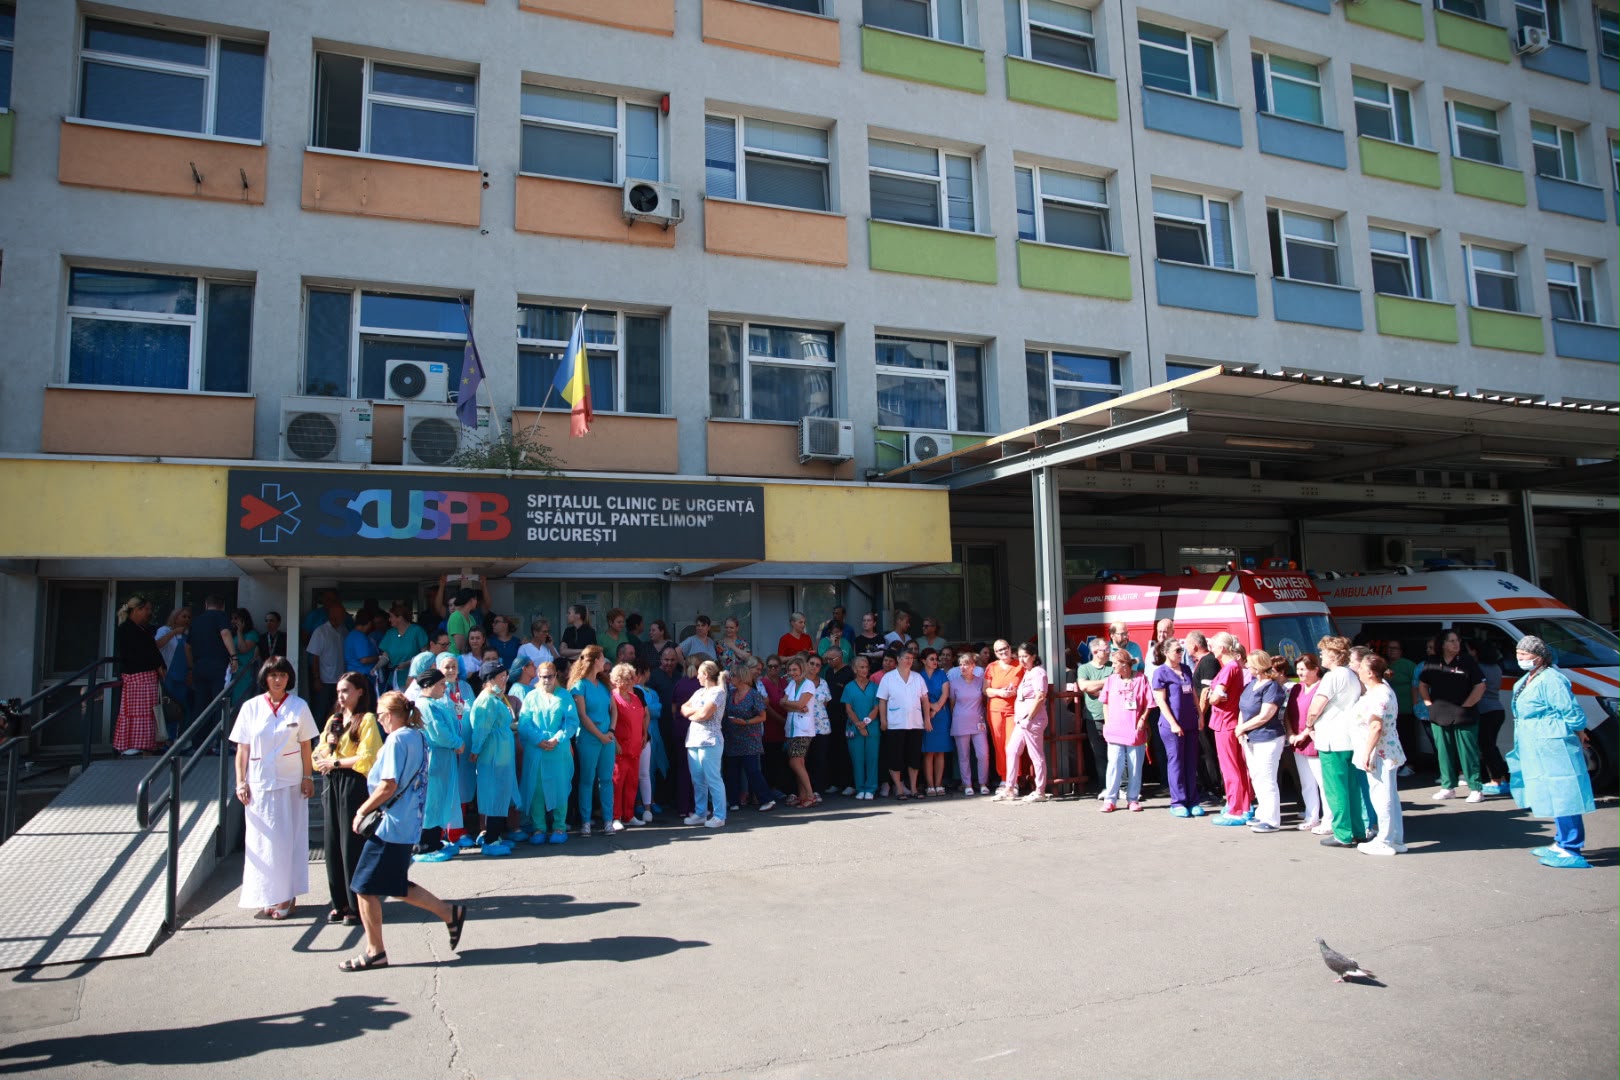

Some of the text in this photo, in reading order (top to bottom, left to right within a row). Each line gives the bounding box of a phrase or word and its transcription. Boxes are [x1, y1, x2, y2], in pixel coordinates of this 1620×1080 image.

[527, 494, 602, 509] SPITALUL
[606, 496, 657, 511] CLINIC
[662, 498, 681, 511] DE
[315, 489, 513, 541] SCUSPB
[527, 528, 617, 546] BUCUREȘTI
[1253, 577, 1312, 590] POMPIERII
[1273, 589, 1308, 600] SMURD
